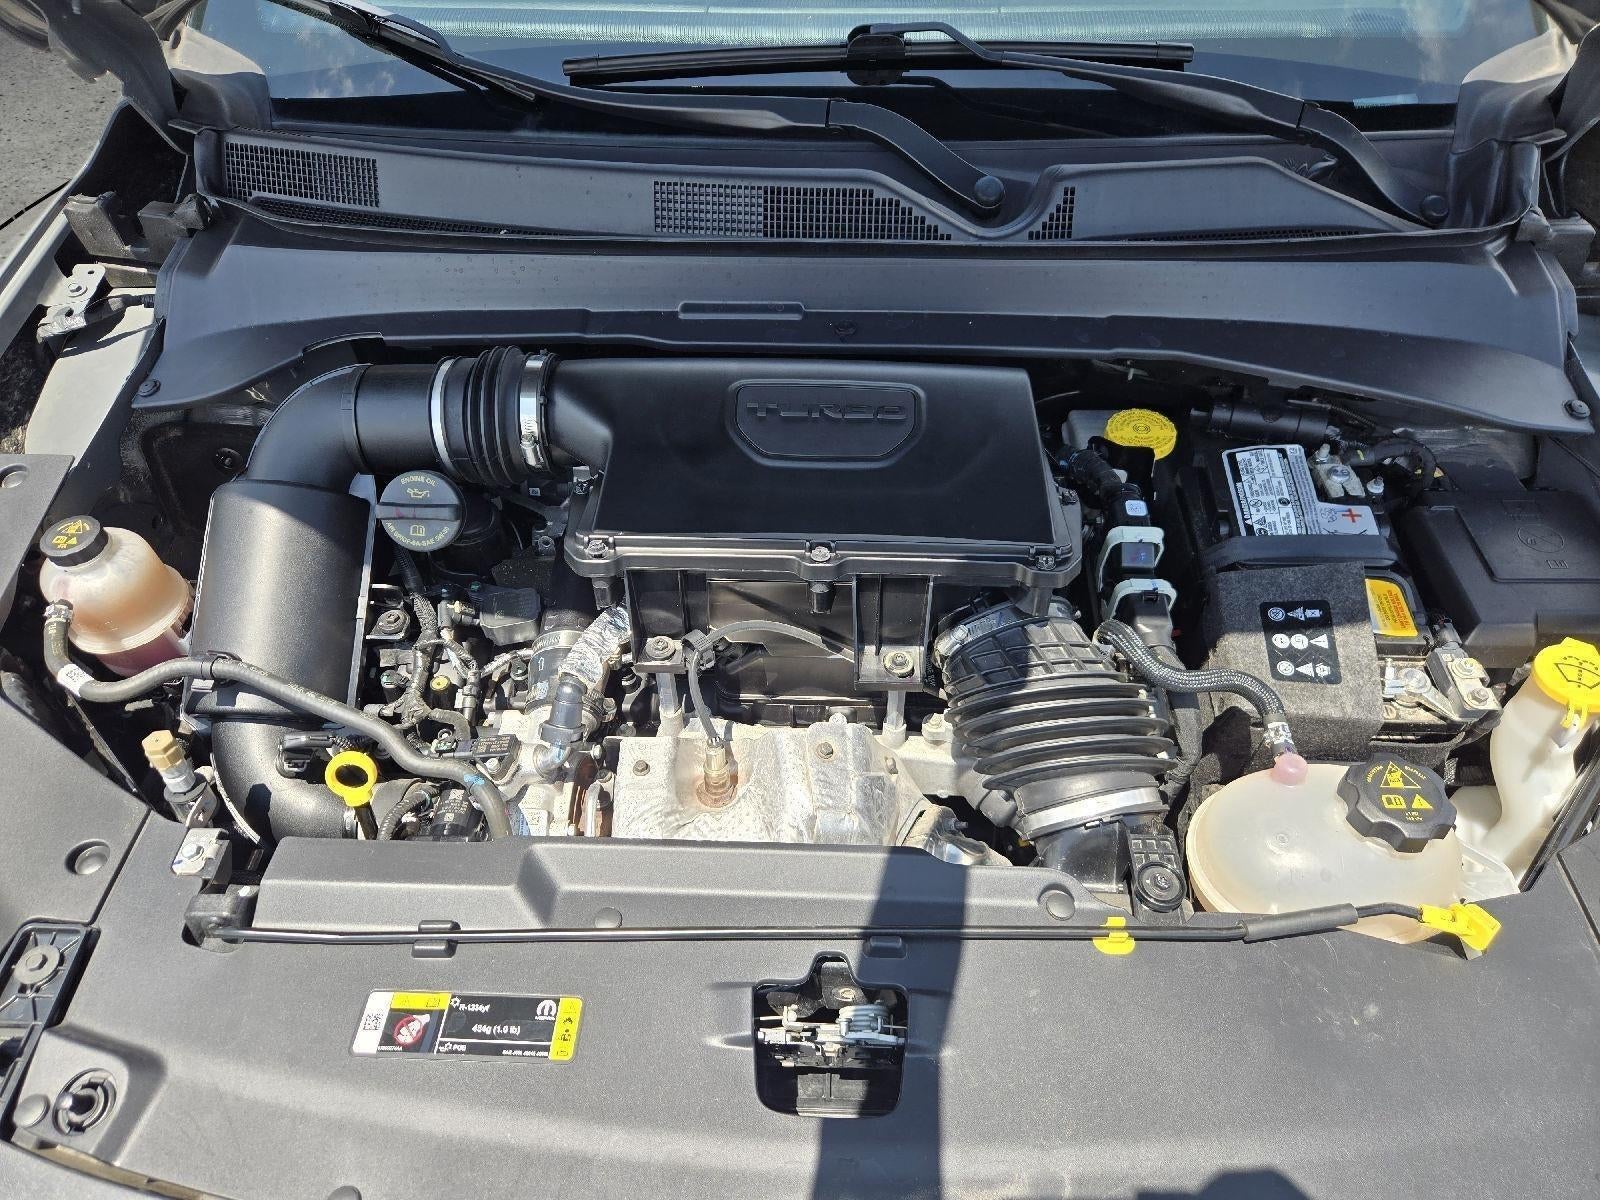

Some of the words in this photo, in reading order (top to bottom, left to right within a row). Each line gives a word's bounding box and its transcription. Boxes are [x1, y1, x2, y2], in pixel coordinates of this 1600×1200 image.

[746, 402, 908, 420] TURBO
[400, 475, 426, 485] ENGINE
[426, 476, 437, 487] OIL
